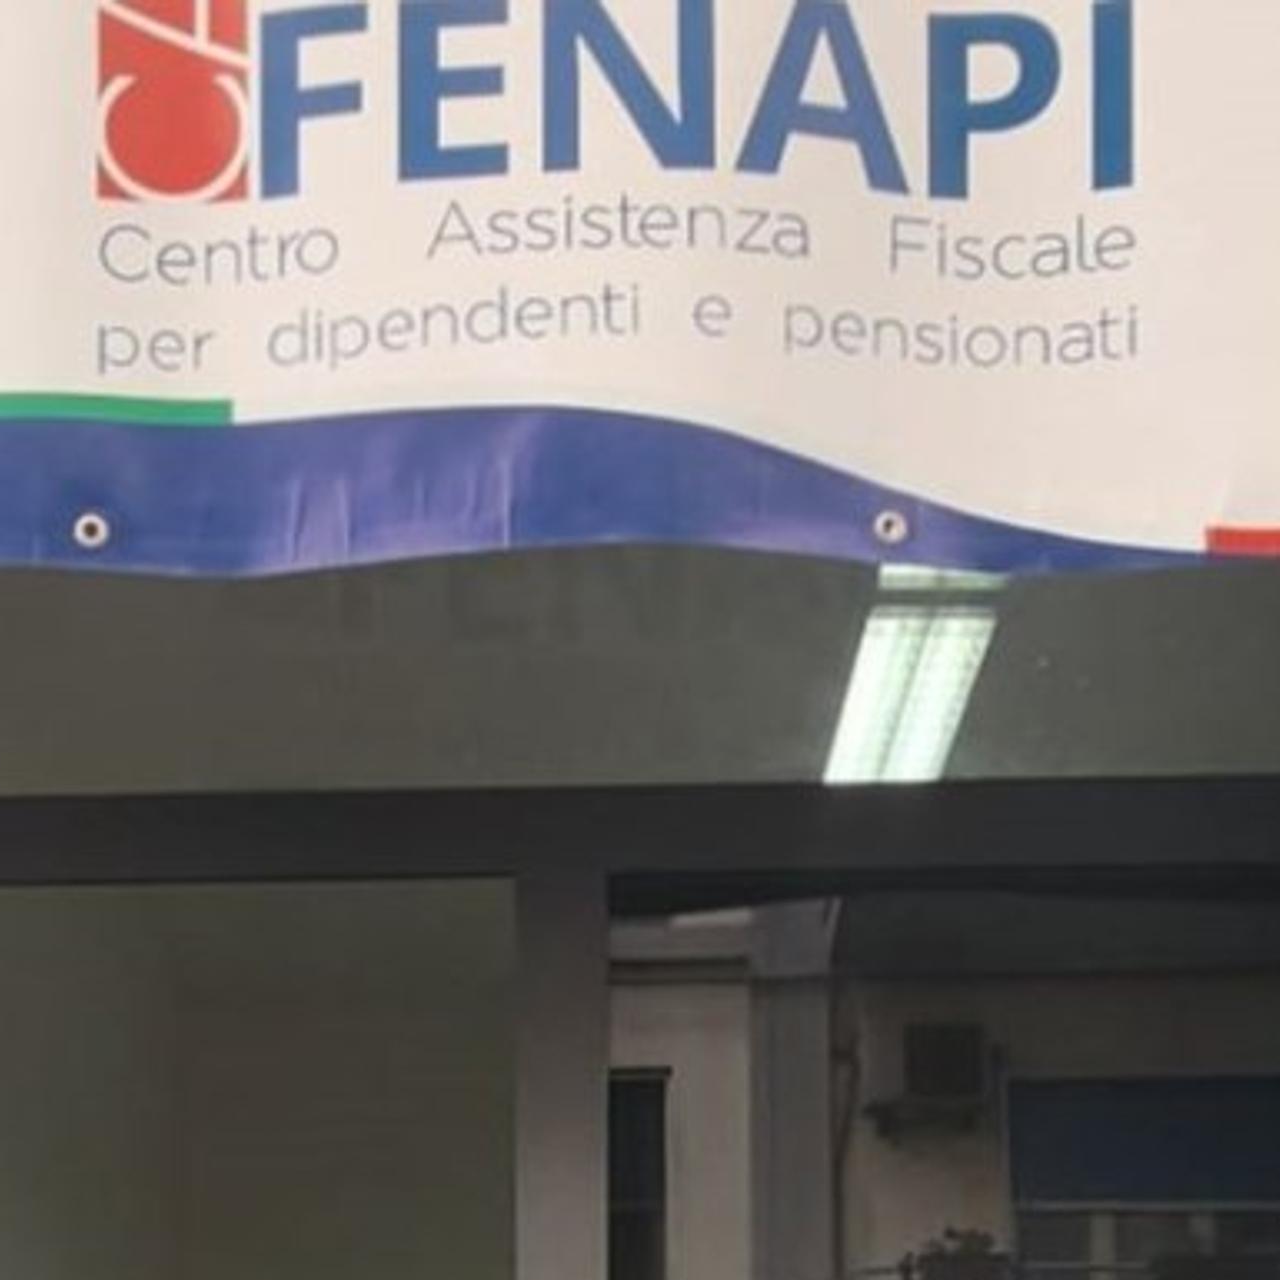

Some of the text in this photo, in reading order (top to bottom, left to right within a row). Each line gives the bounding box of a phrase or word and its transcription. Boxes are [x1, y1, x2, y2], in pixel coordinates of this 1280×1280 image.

[260, 0, 1134, 201] FENAPI
[98, 194, 1138, 287] Centro Assistenza Fiscale
[96, 284, 1139, 376] per dipendenti e pensionati
